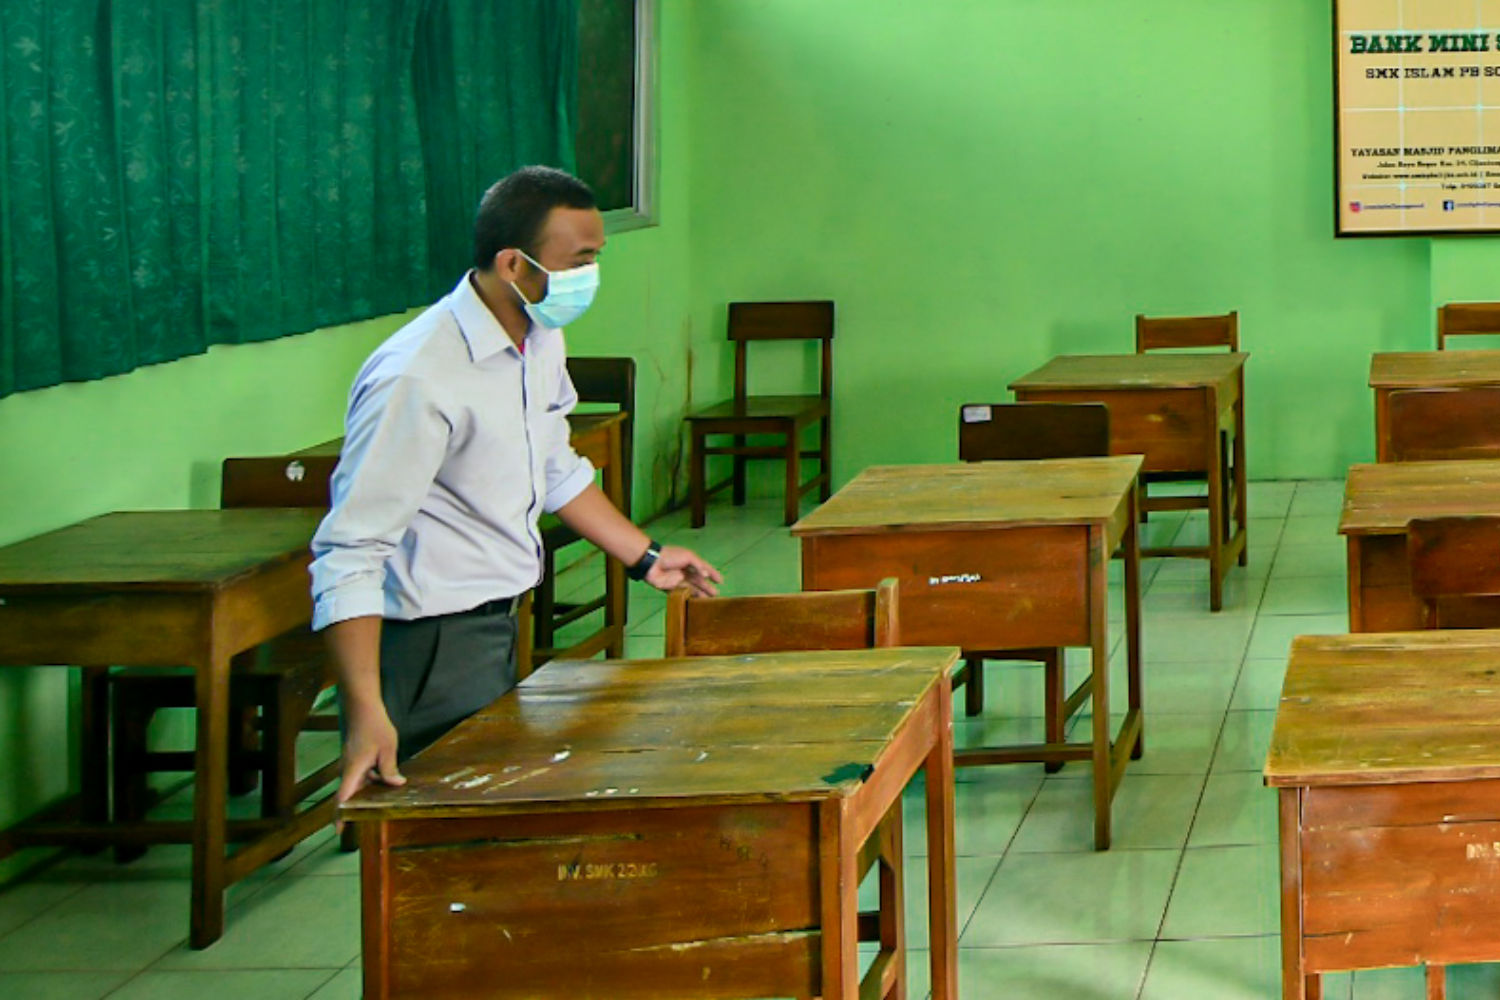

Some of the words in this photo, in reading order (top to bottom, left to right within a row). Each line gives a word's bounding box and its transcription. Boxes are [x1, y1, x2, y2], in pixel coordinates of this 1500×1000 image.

[1350, 34, 1423, 53] BANK
[1428, 34, 1490, 52] MINI
[1366, 68, 1399, 79] SMK
[1404, 67, 1454, 78] ISLAM
[1459, 66, 1480, 77] PB
[1350, 148, 1401, 157] YAYASAN
[1404, 147, 1444, 156] MASJID
[585, 863, 615, 879] SMK
